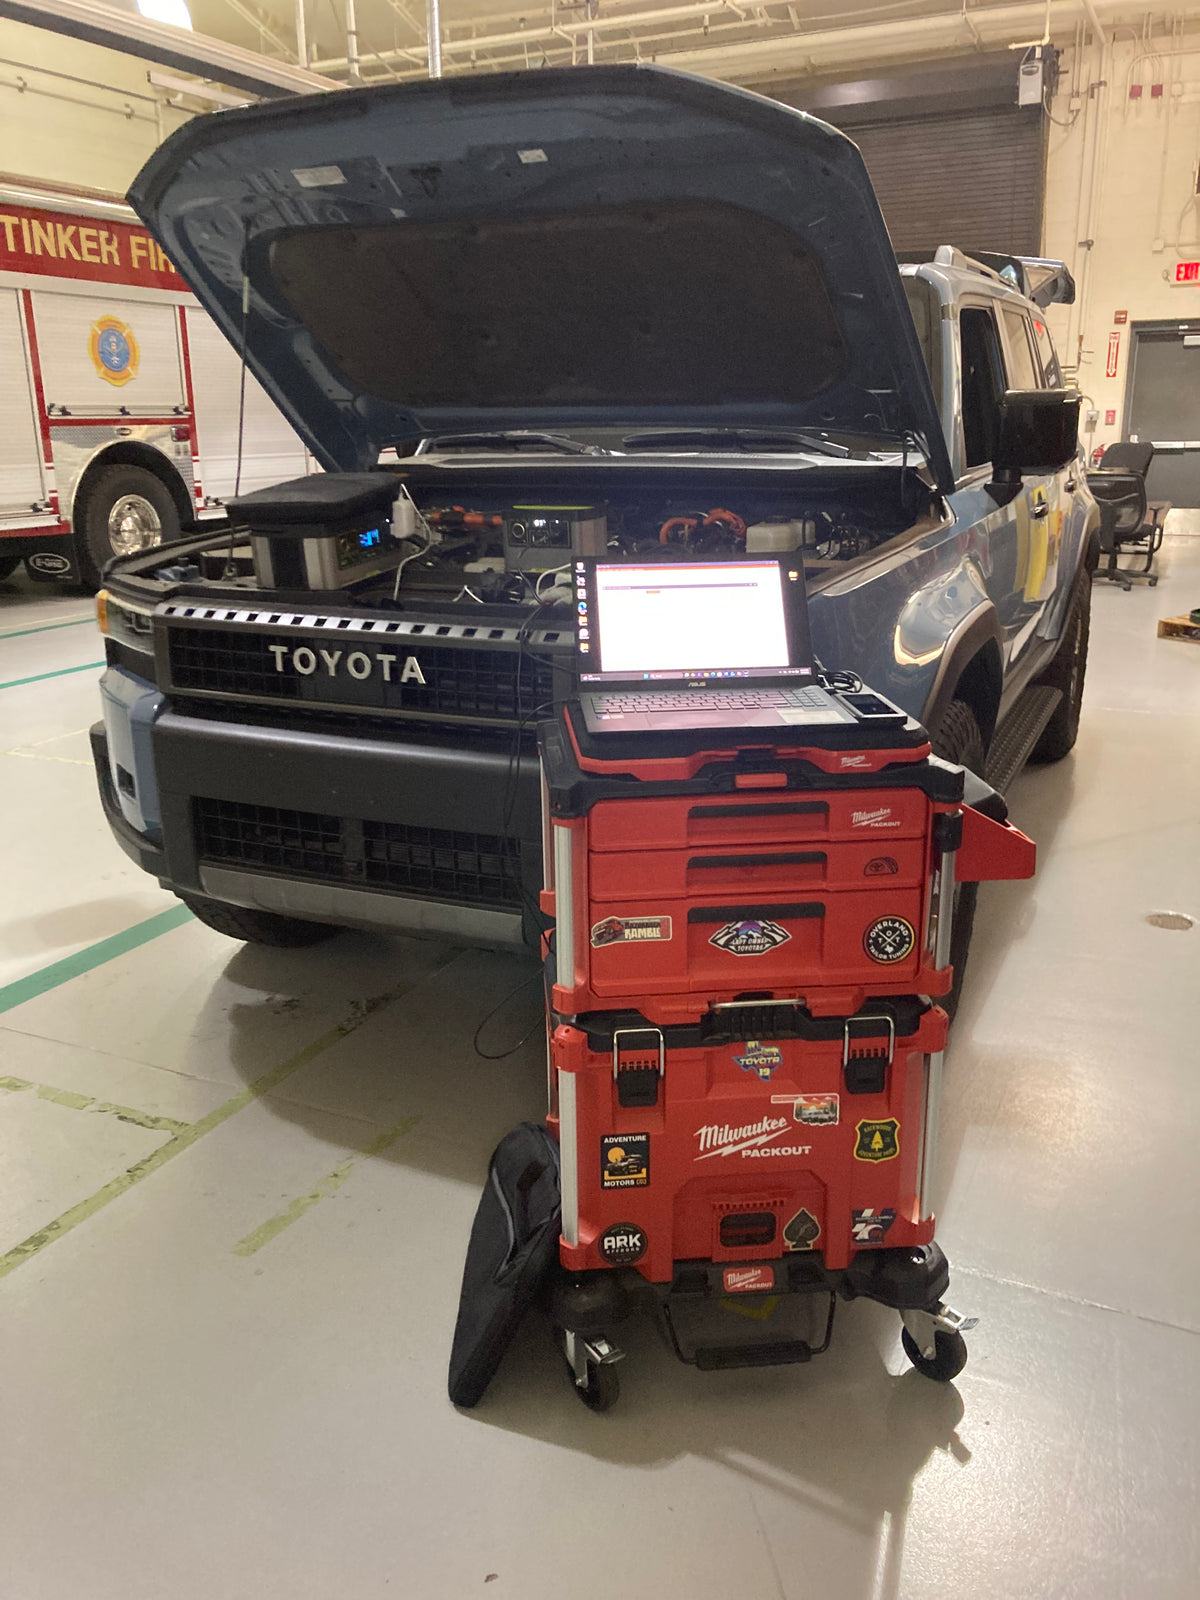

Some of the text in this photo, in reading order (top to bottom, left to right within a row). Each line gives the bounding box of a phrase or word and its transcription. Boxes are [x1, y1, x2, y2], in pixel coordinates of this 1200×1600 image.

[0, 214, 121, 266] TINKER
[1176, 261, 1200, 281] EXIT
[268, 644, 427, 685] TOYOTA
[851, 808, 891, 824] Milwaukee
[870, 920, 909, 938] OVERLAND
[740, 1056, 780, 1065] TOYOTA
[604, 1134, 646, 1144] ADVENTURE
[693, 1116, 788, 1152] Milwaukee
[741, 1145, 812, 1159] PACKOUT
[603, 1179, 635, 1187] MOTORS
[603, 1233, 641, 1250] ARK
[727, 1268, 762, 1286] Milwaukee
